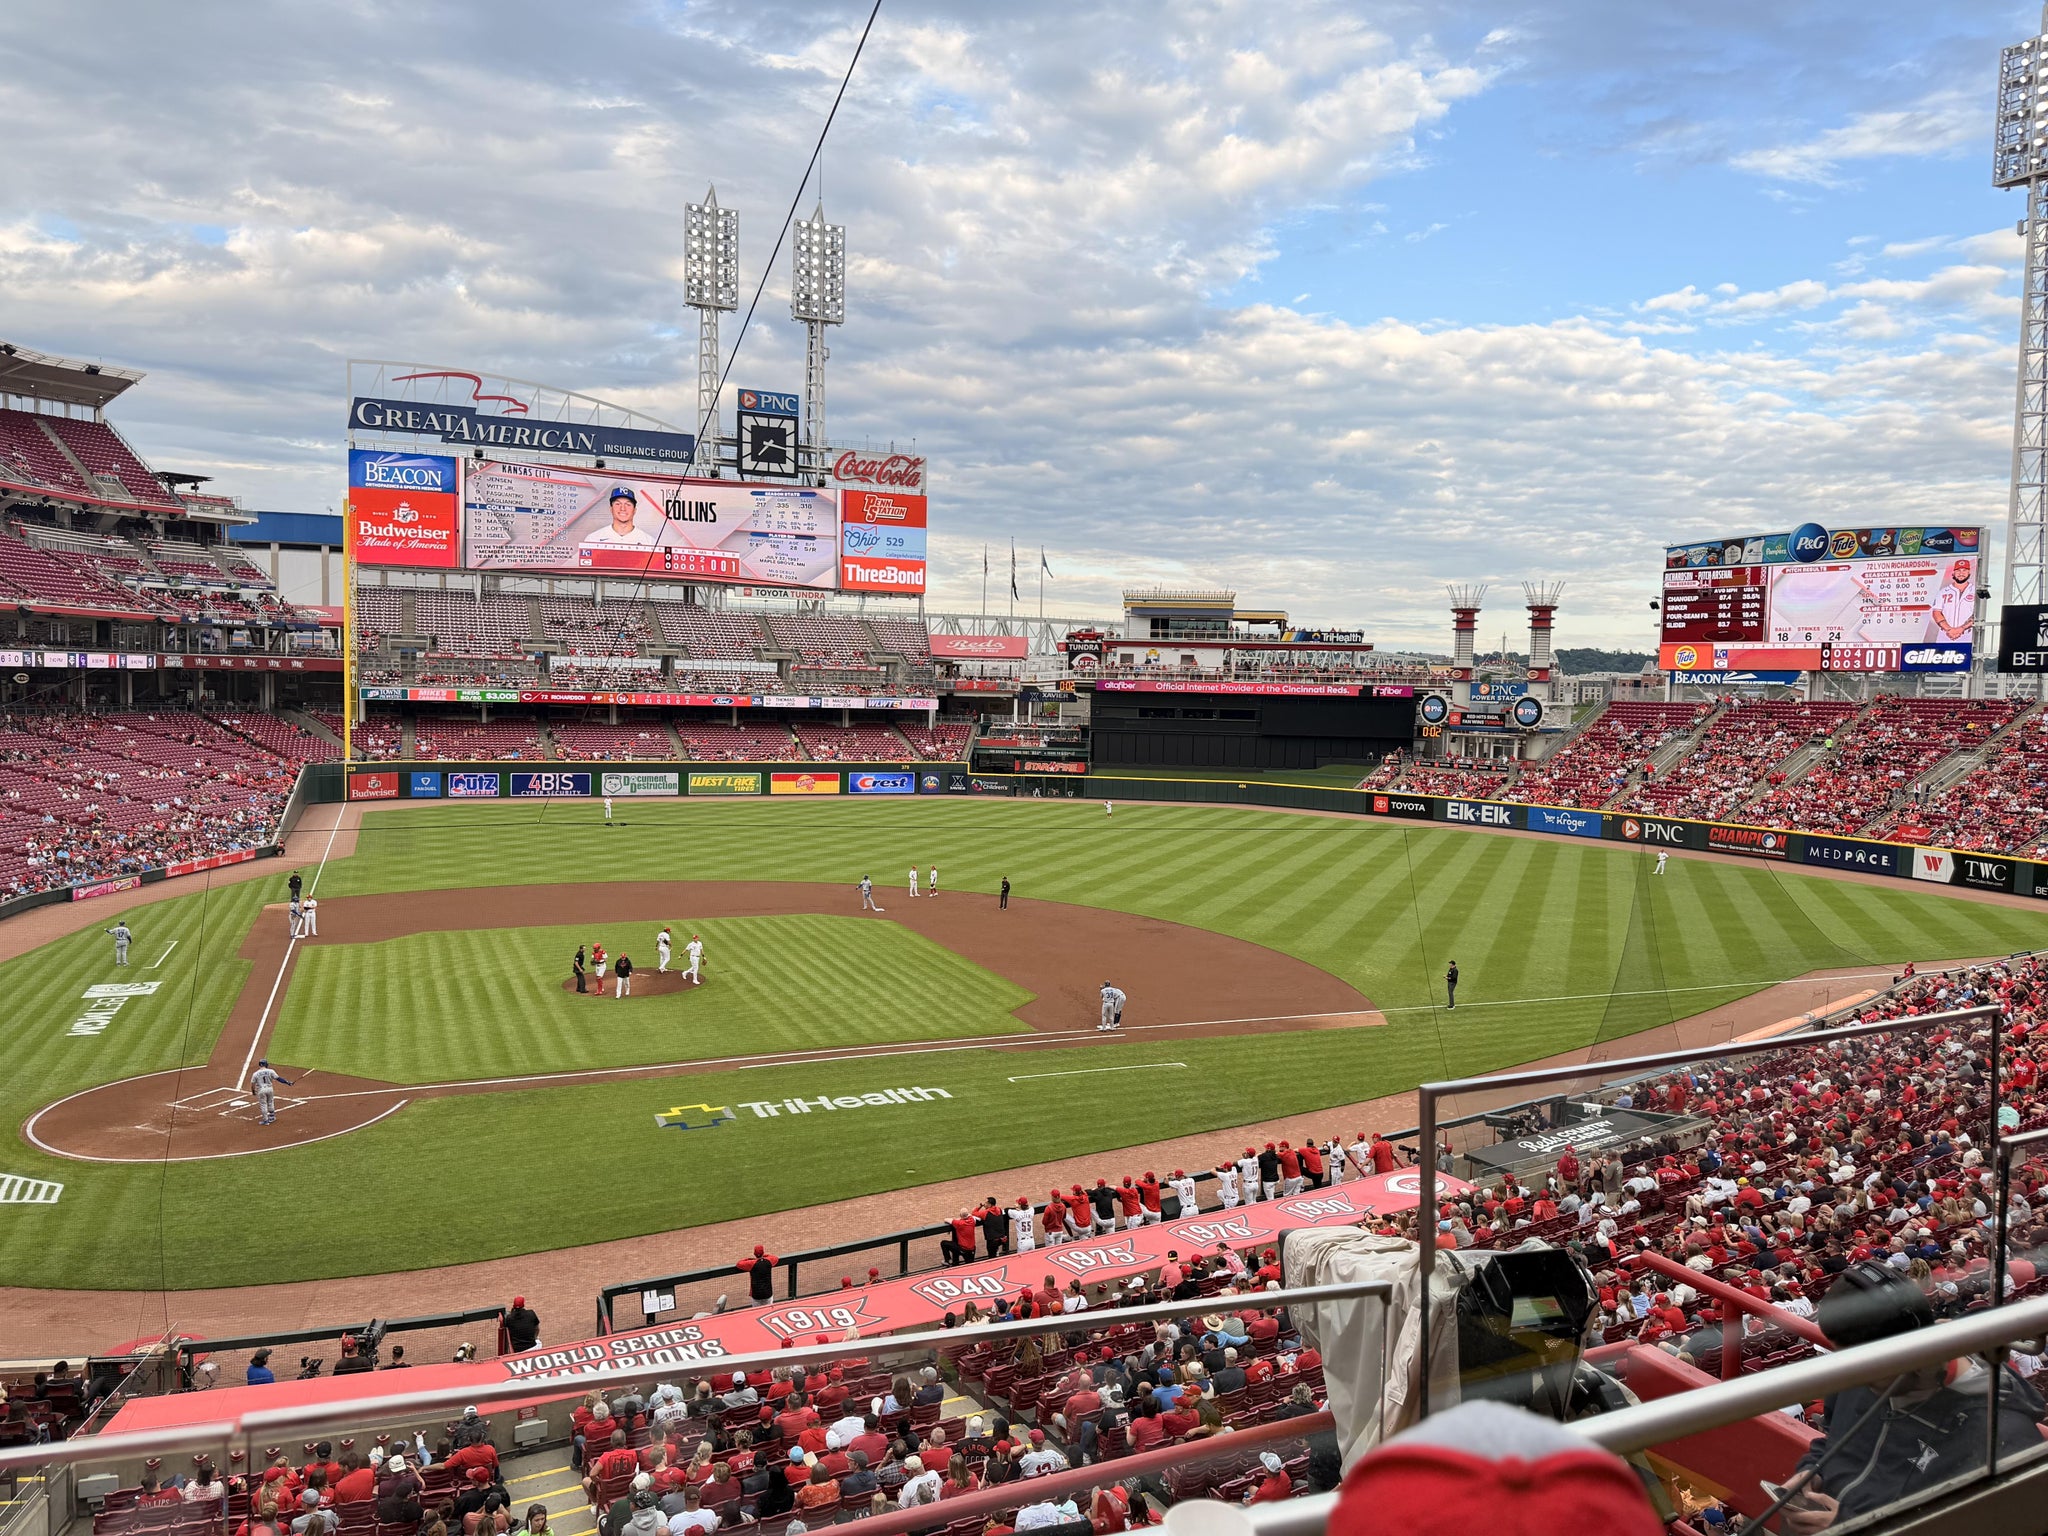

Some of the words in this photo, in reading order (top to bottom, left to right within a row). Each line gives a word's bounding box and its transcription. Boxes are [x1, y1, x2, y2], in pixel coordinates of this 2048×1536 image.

[760, 394, 797, 412] PNC
[357, 402, 458, 432] GREAT
[448, 417, 596, 452] AMERICAN
[604, 444, 656, 456] INSURANCE
[659, 449, 689, 459] GROUP
[365, 461, 442, 486] BEACON
[502, 465, 532, 476] KANSAS
[536, 470, 550, 478] CITY
[832, 451, 926, 488] Coca-Cola
[864, 494, 893, 512] PENN
[666, 500, 717, 522] COLLINS
[866, 507, 907, 523] STATION
[359, 520, 449, 539] Budweiser
[357, 536, 392, 546] Made
[393, 539, 403, 549] of
[403, 539, 448, 550] America
[844, 530, 880, 547] Ohio
[886, 538, 904, 546] 529
[1796, 535, 1825, 550] P&G
[1832, 536, 1855, 552] Tide
[886, 552, 924, 560] CollegeAdvantage
[1766, 546, 1787, 556] Pampers
[711, 560, 716, 571] 0
[721, 561, 726, 572] 0
[844, 564, 923, 584] ThreeBond
[1665, 571, 1693, 581] RICHARDSON
[1698, 571, 1711, 580] PITCH
[1711, 569, 1733, 580] ARSENAL
[756, 589, 788, 598] TOYOTA
[790, 591, 826, 599] TUNDRA
[1942, 594, 1953, 604] 72
[1322, 633, 1361, 642] TriHealth
[1778, 632, 1788, 642] 18
[1805, 632, 1812, 642] 6
[1829, 632, 1840, 641] 24
[946, 640, 1006, 651] Reds
[1677, 652, 1694, 663] Tide
[1905, 649, 1964, 664] Gillette
[2012, 651, 2048, 665] BET
[1674, 671, 1721, 684] BEACON
[1060, 681, 1075, 691] 0:02
[1105, 681, 1136, 690] altafiber
[1156, 682, 1183, 691] Official
[1186, 683, 1216, 692] Internet
[1218, 684, 1253, 693] Provider
[1264, 685, 1280, 693] the
[1282, 685, 1325, 694] Cincinnati
[1328, 686, 1349, 695] Reds.
[1491, 685, 1517, 695] PNC
[486, 692, 517, 700] $3,005
[1423, 727, 1441, 737] 0:02
[528, 773, 574, 791] 4BIS
[624, 775, 667, 785] Document
[631, 781, 677, 793] Destruction
[691, 776, 725, 786] WEST
[727, 776, 757, 786] LAKE
[858, 776, 907, 788] Crest
[352, 789, 396, 798] Budweiser
[1391, 801, 1425, 812] TOYOTA
[1447, 802, 1510, 825] Elk+Elk
[1556, 812, 1586, 832] Kroger
[1645, 822, 1684, 842] PNC
[1709, 827, 1787, 850] CHAMPION
[1810, 846, 1888, 867] MEDPACE
[1924, 856, 1943, 871] W
[1965, 860, 2006, 881] TWC
[65, 996, 130, 1036] BETMGM
[737, 1086, 953, 1118] TriHealth
[1560, 1120, 1614, 1136] COUNTRY
[1570, 1128, 1612, 1143] CARES
[1518, 1135, 1569, 1156] Reds
[1185, 1187, 1193, 1197] 30
[1287, 1196, 1355, 1217] 1990
[1021, 1221, 1032, 1232] 55
[1178, 1222, 1254, 1242] 1976
[1059, 1244, 1136, 1271] 1975
[922, 1275, 1004, 1301] 1940
[770, 1308, 849, 1336] 1919
[506, 1345, 604, 1374] WORLD
[611, 1326, 703, 1354] SERIES
